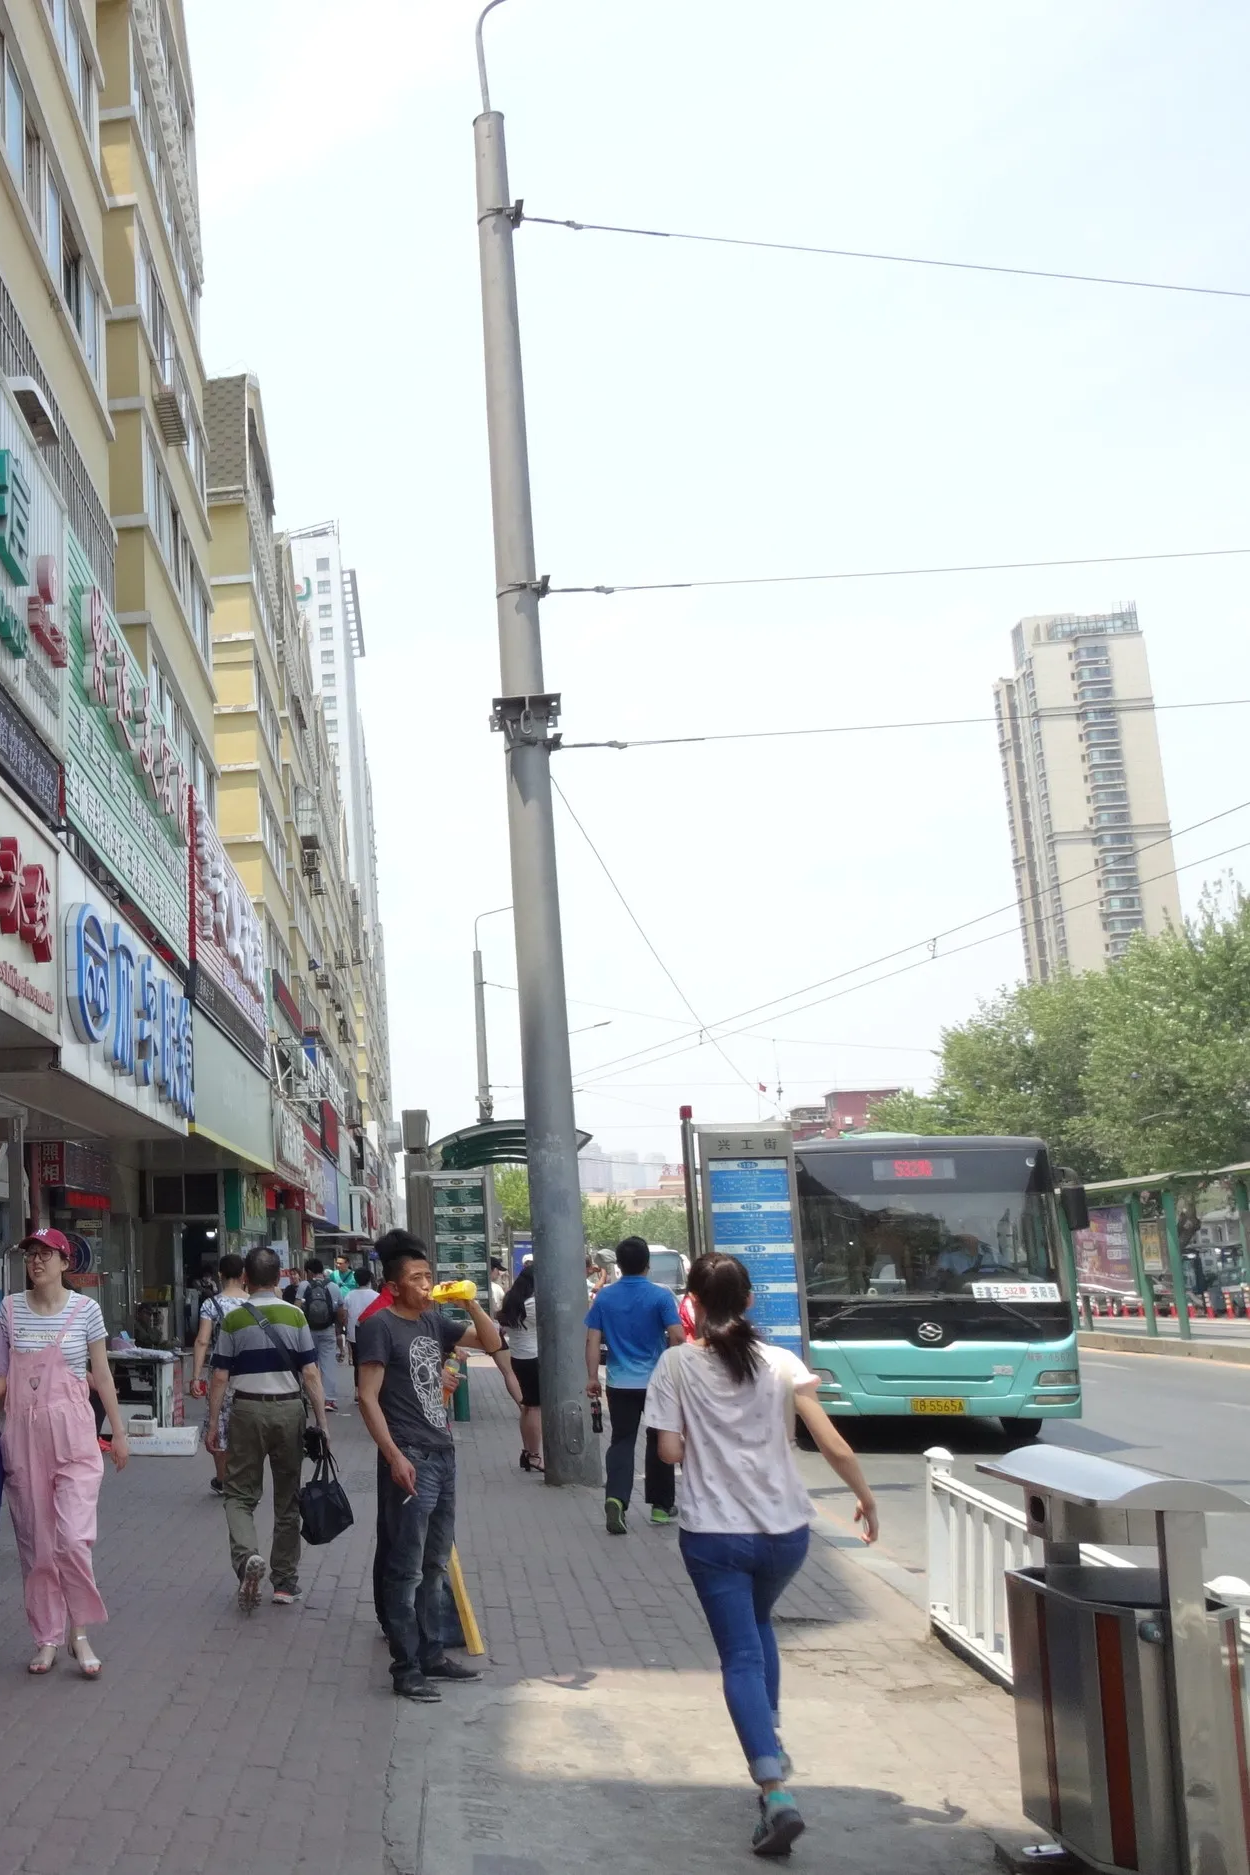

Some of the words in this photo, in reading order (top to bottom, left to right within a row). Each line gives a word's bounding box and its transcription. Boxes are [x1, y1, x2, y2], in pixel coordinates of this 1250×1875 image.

[717, 1138, 779, 1151] 兴工街
[41, 1141, 61, 1182] 照相
